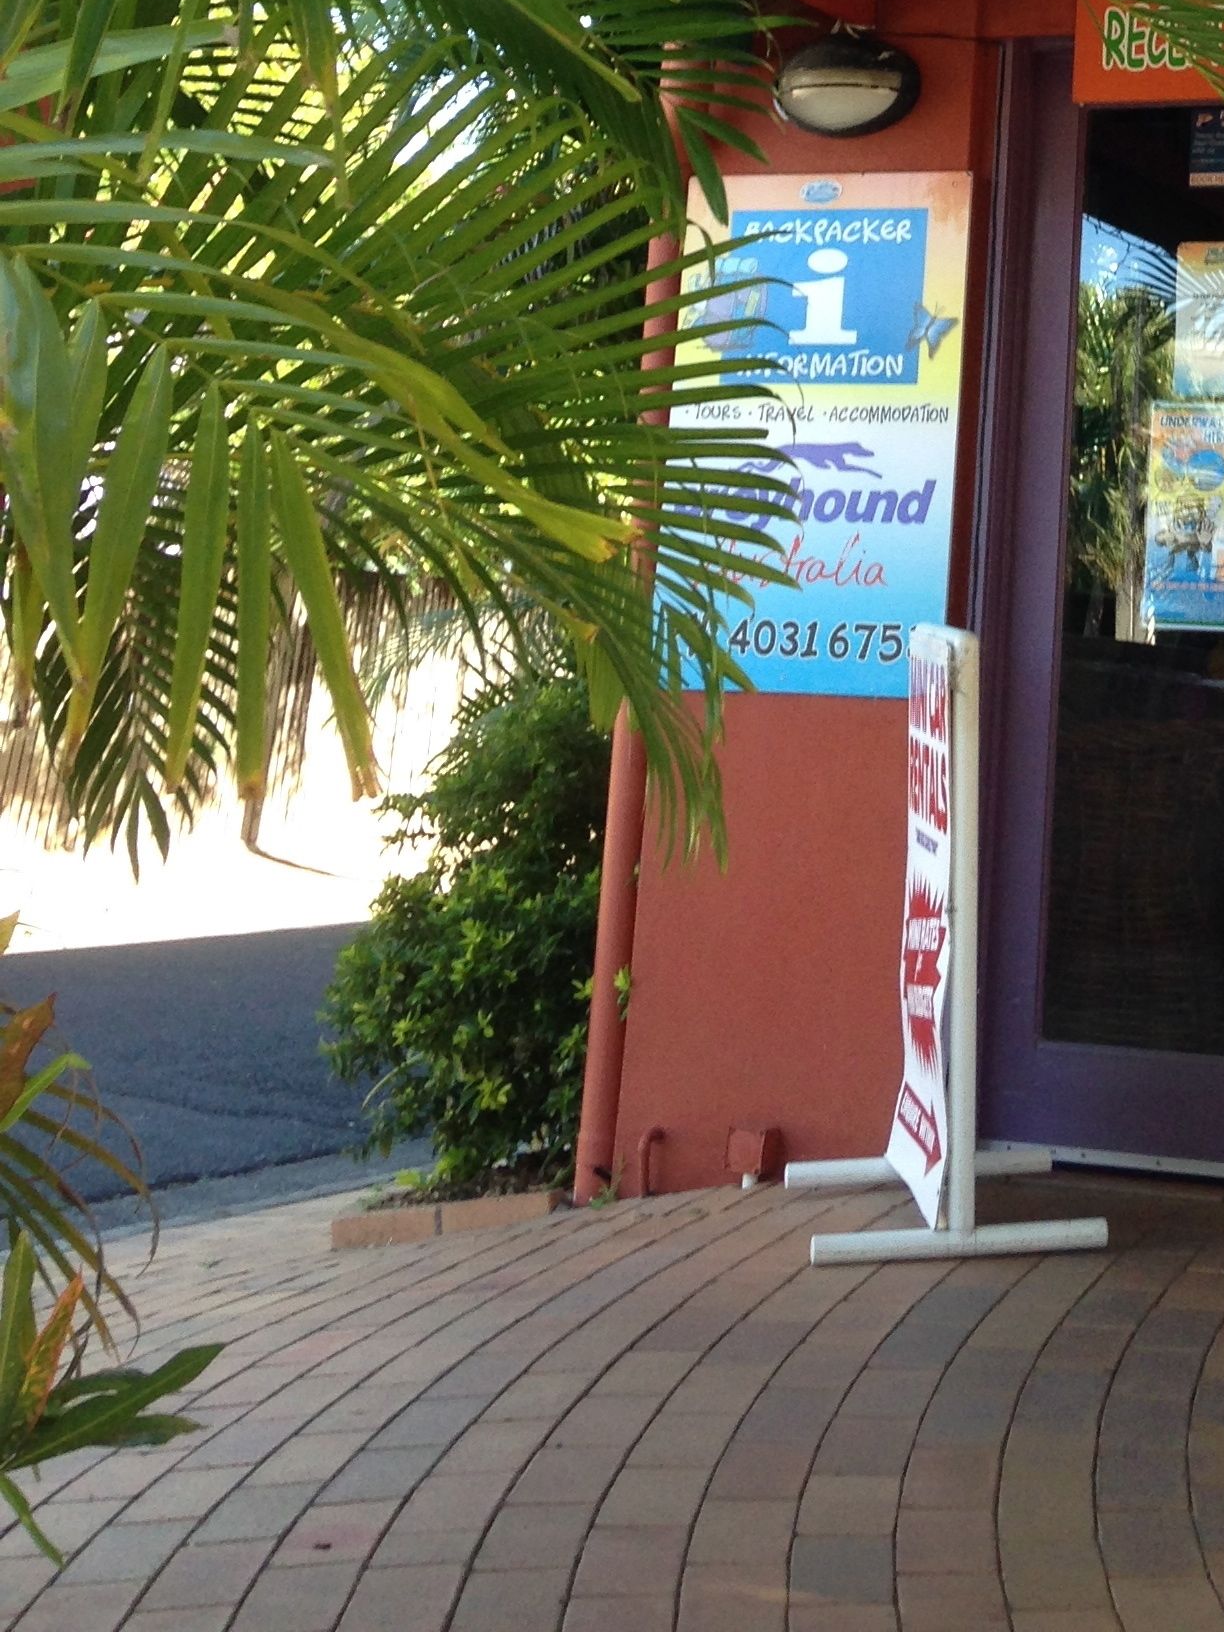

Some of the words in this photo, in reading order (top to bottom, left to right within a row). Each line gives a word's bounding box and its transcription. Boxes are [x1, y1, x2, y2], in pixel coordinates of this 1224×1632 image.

[743, 217, 911, 245] BACKPACKER
[735, 349, 903, 380] FORMATION
[694, 403, 742, 420] TOURS
[757, 403, 814, 423] TRAVEL
[829, 405, 950, 424] ACCOMMODATION
[728, 620, 819, 658] 4031
[828, 621, 913, 664] 675
[911, 735, 948, 835] RENTALS
